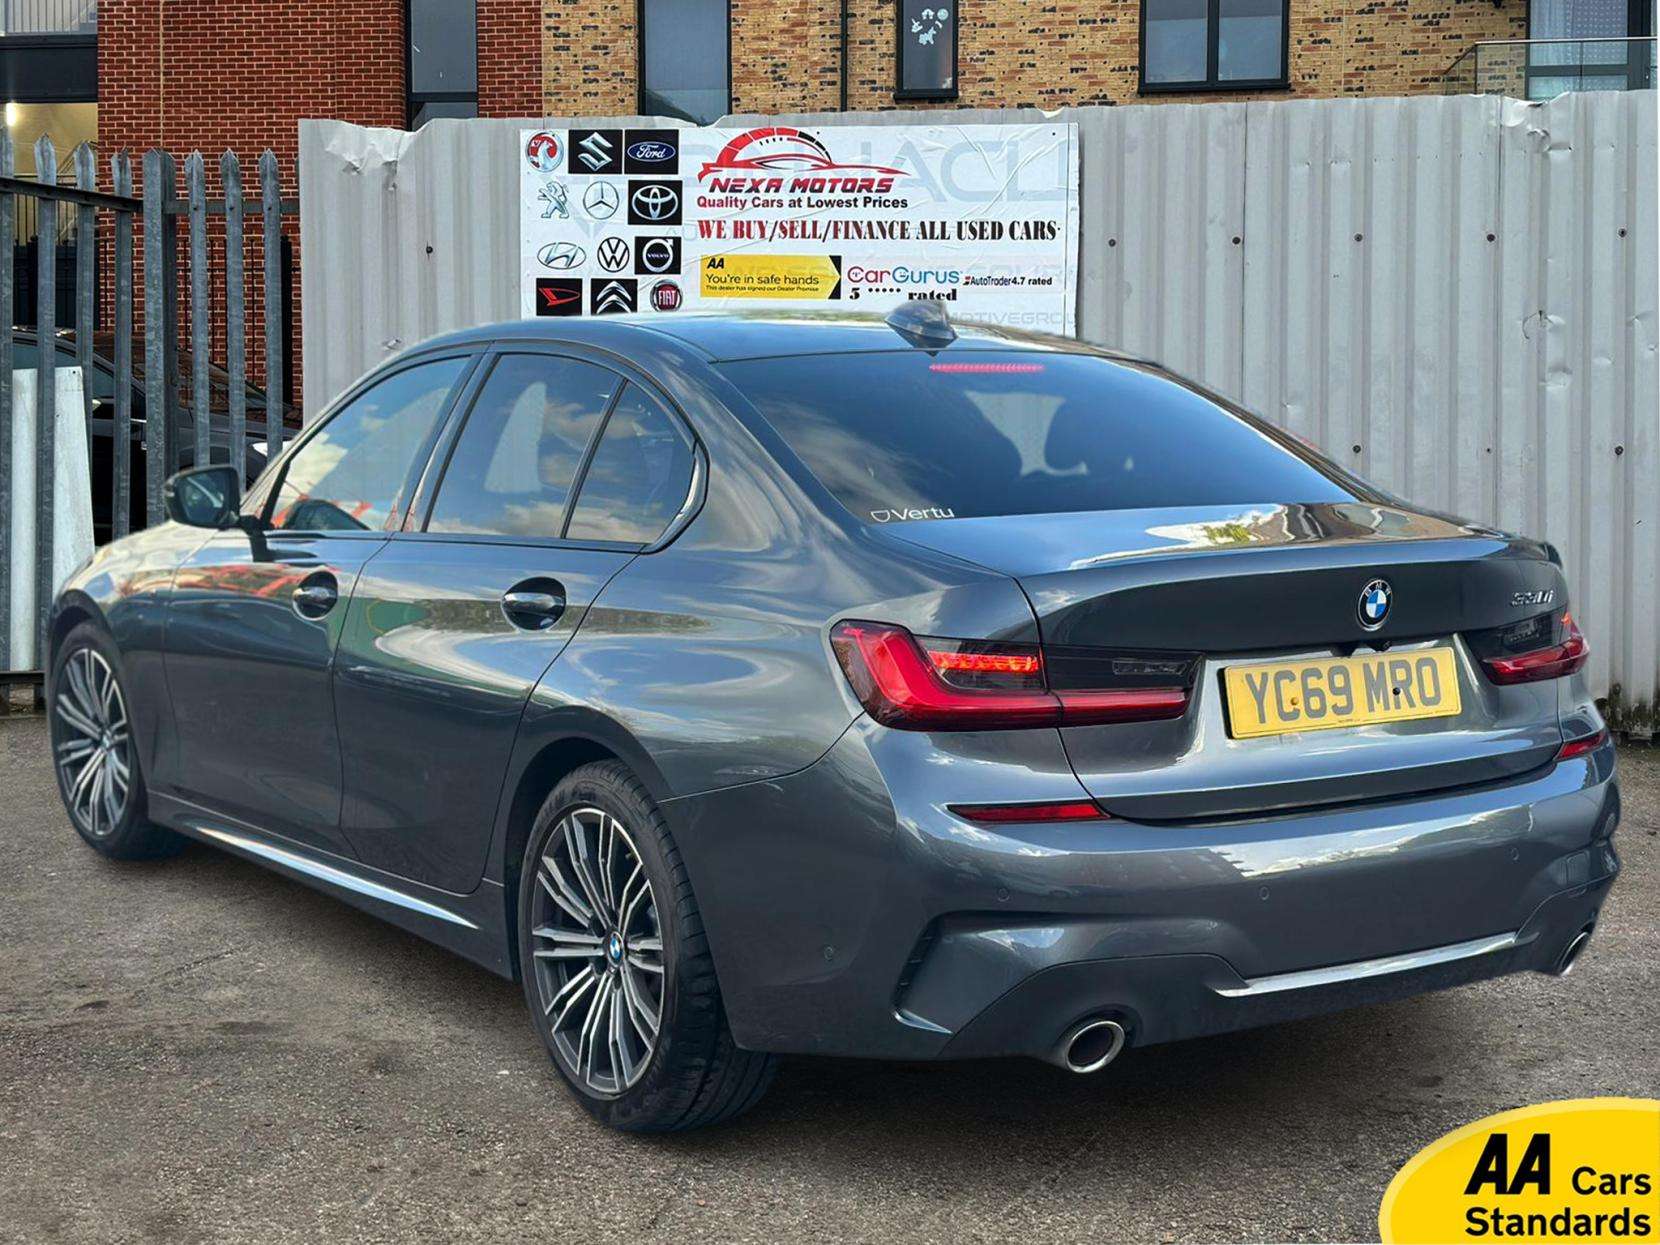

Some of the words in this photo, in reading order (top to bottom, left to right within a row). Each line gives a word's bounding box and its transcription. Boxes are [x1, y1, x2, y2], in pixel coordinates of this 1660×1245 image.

[636, 144, 667, 160] Ford
[709, 177, 784, 194] NEXA
[789, 177, 894, 194] MOTORS
[697, 196, 748, 211] Quality
[751, 196, 784, 208] Cars
[788, 196, 803, 208] at
[807, 196, 858, 208] Lowest
[863, 196, 908, 208] Prices
[698, 219, 727, 240] WE
[733, 219, 910, 243] BUY/SELL/FINANCE
[915, 220, 951, 240] ALL
[956, 220, 1003, 240] USED
[1008, 220, 1057, 240] CARS
[706, 257, 725, 269] AA
[706, 273, 740, 284] You're
[744, 273, 754, 284] in
[757, 274, 781, 284] safe
[784, 274, 820, 285] hands
[847, 266, 960, 284] CarGurus
[1028, 277, 1052, 286] rated
[658, 290, 676, 306] FIAT
[849, 287, 860, 300] 5
[908, 288, 957, 301] rated
[890, 507, 955, 520] Vertu
[1245, 664, 1354, 724] YC69
[1365, 656, 1441, 713] MRO
